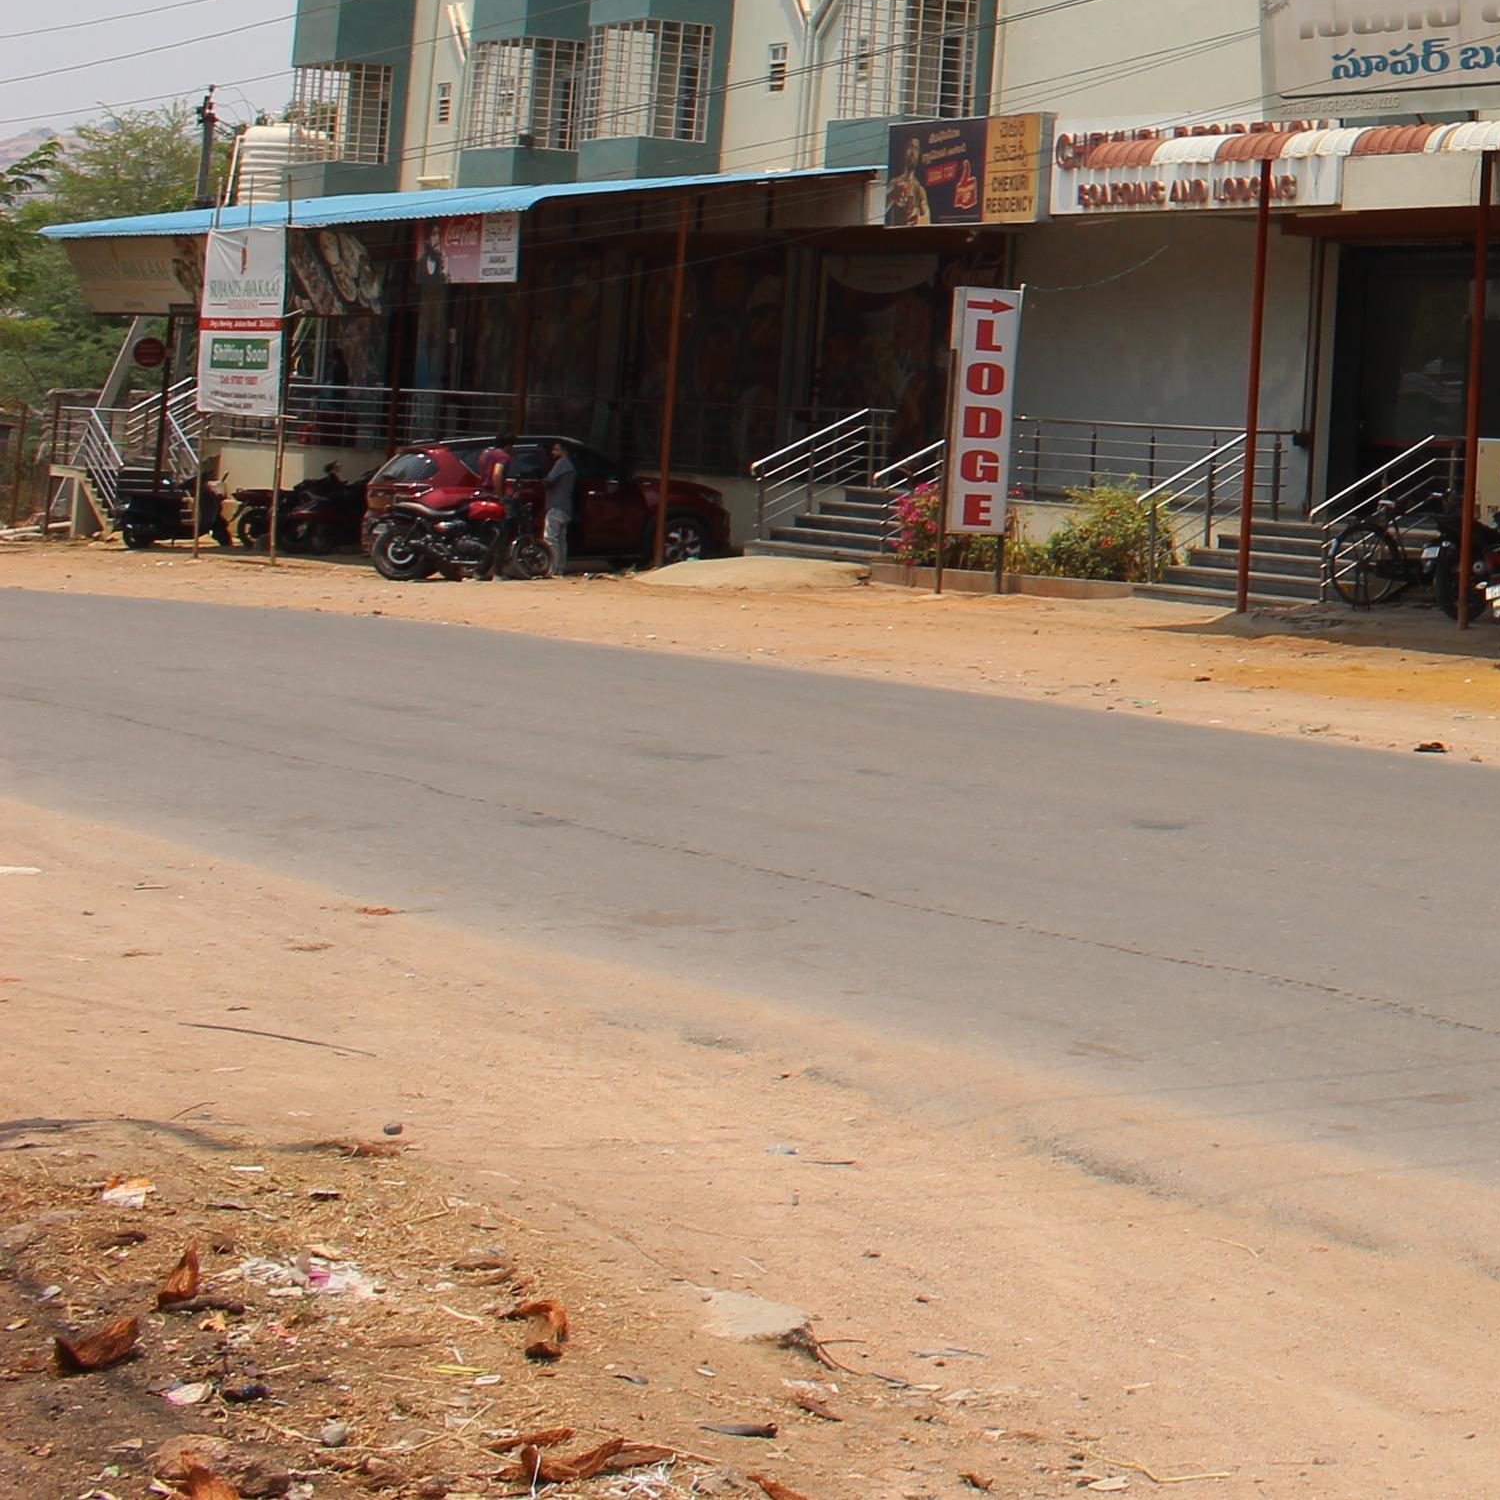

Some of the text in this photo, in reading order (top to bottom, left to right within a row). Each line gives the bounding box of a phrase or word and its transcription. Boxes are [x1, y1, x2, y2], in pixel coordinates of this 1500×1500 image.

[1331, 37, 1450, 80] సూపర్
[992, 174, 1029, 192] CHEKURI
[1078, 180, 1165, 207] BOARDING
[1169, 179, 1209, 203] AND
[986, 196, 1034, 213] RESIDENCY
[213, 343, 267, 367] Shifting Soon
[960, 319, 1005, 527] LODGE
